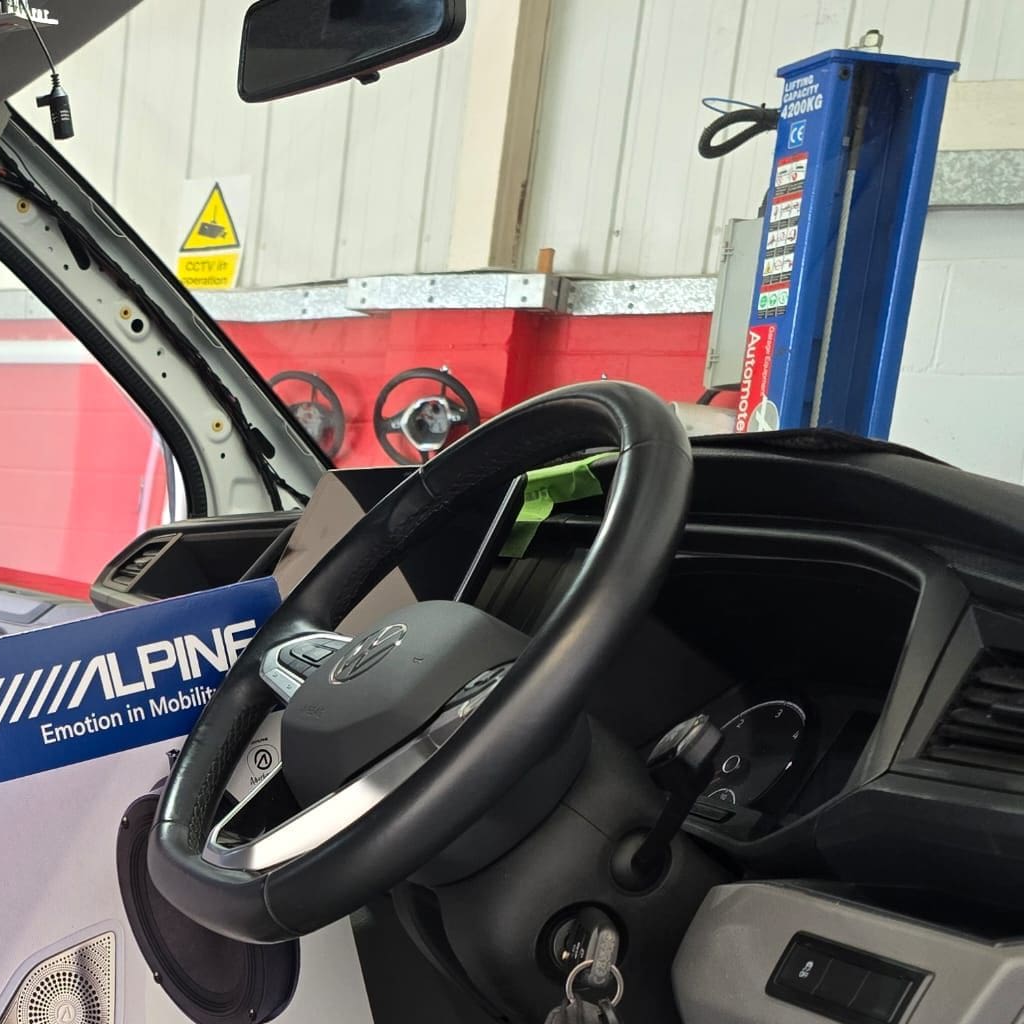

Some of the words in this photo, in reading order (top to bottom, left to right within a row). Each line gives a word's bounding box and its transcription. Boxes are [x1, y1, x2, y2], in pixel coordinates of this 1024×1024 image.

[783, 83, 820, 103] CAPACITY
[784, 74, 814, 93] LIFTING
[780, 93, 823, 119] 4200KG
[185, 260, 216, 273] CCTV
[40, 712, 124, 745] Emotion
[126, 703, 146, 723] in
[148, 686, 217, 718] Mobilit
